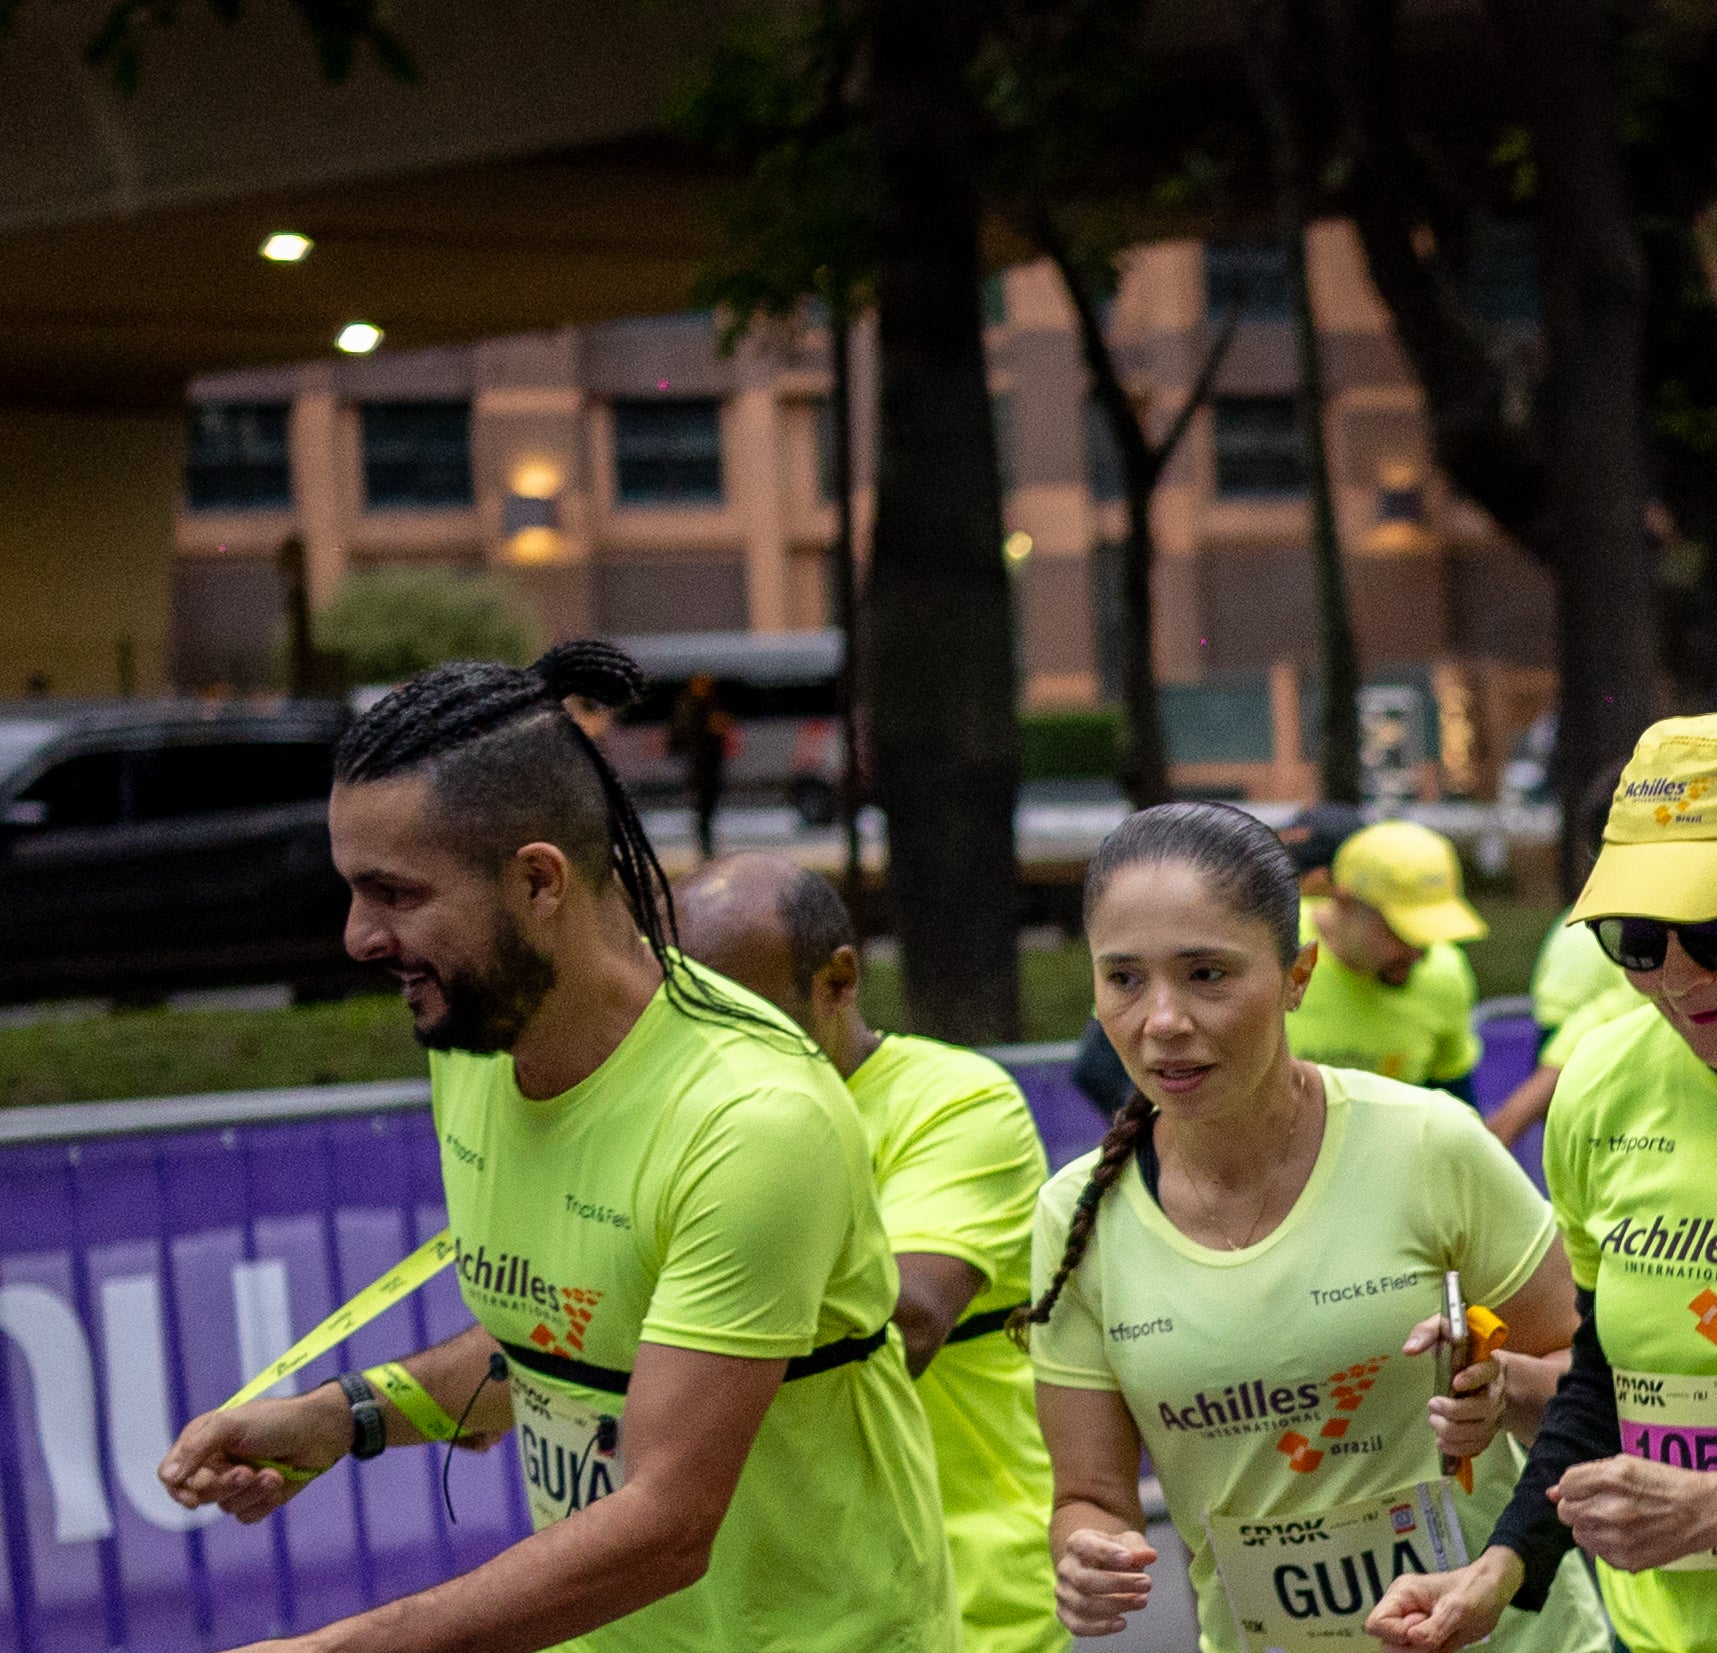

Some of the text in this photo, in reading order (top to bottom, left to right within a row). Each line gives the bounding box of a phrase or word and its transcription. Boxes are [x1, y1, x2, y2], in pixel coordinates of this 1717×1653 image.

[1625, 778, 1686, 797] Achilles
[1109, 1318, 1174, 1342] tfsports
[1158, 1379, 1321, 1431] Achilles
[1240, 1517, 1330, 1546] SP10K
